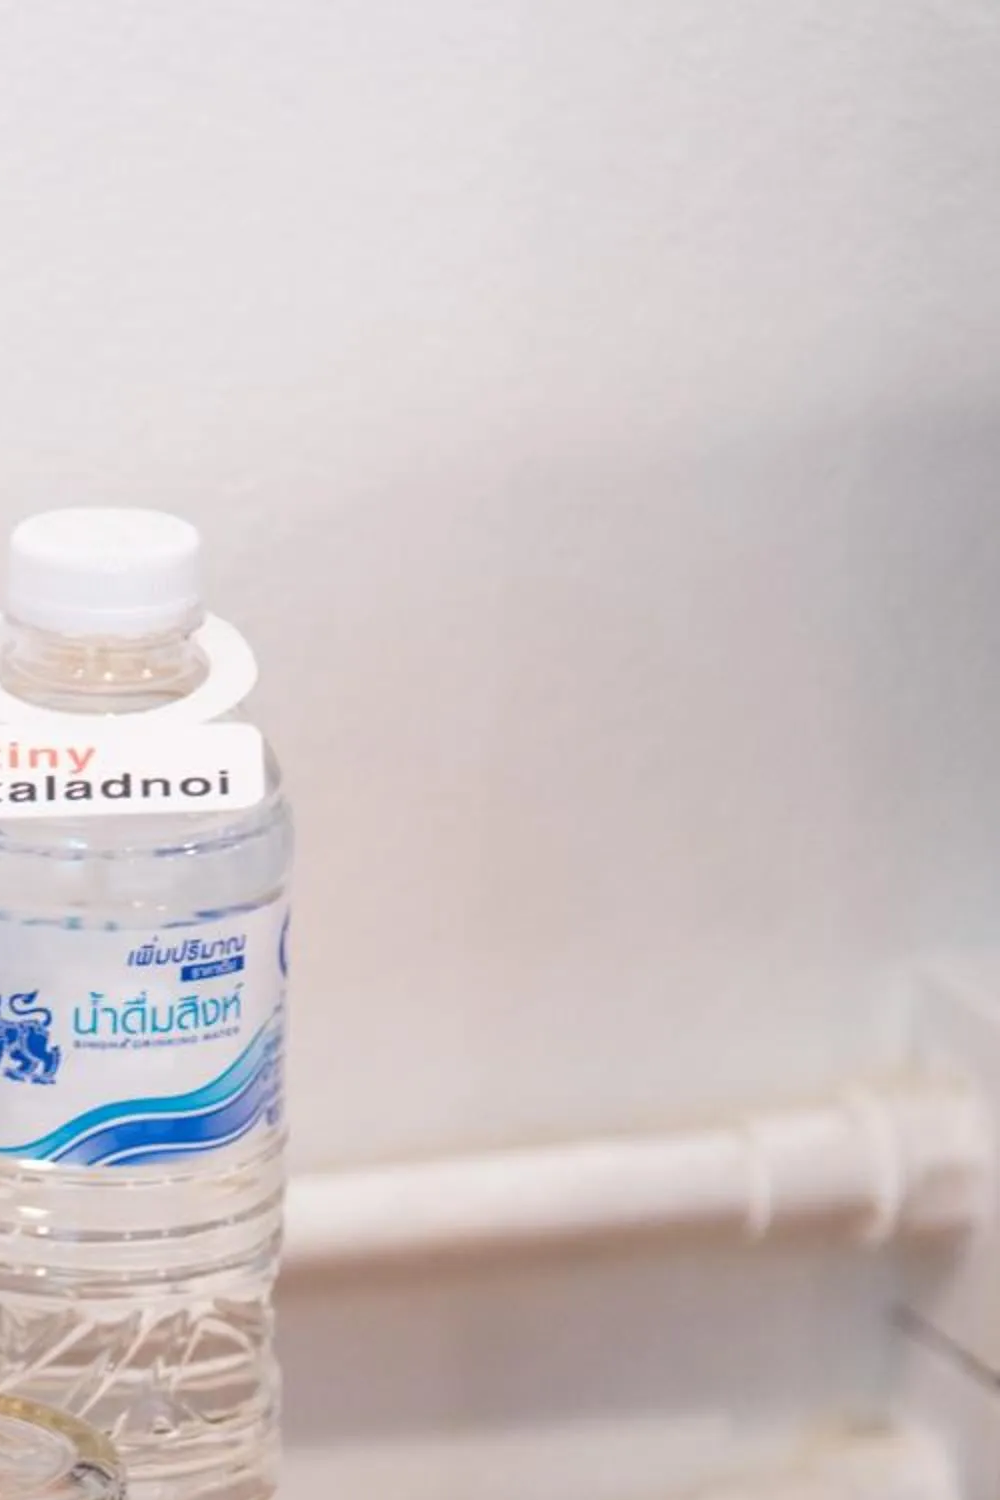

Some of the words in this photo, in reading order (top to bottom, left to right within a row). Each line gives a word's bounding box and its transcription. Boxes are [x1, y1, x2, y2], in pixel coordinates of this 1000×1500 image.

[127, 933, 247, 967] เพิ่มปริมาณ
[73, 982, 244, 1035] น้ำดื่มสิงห์
